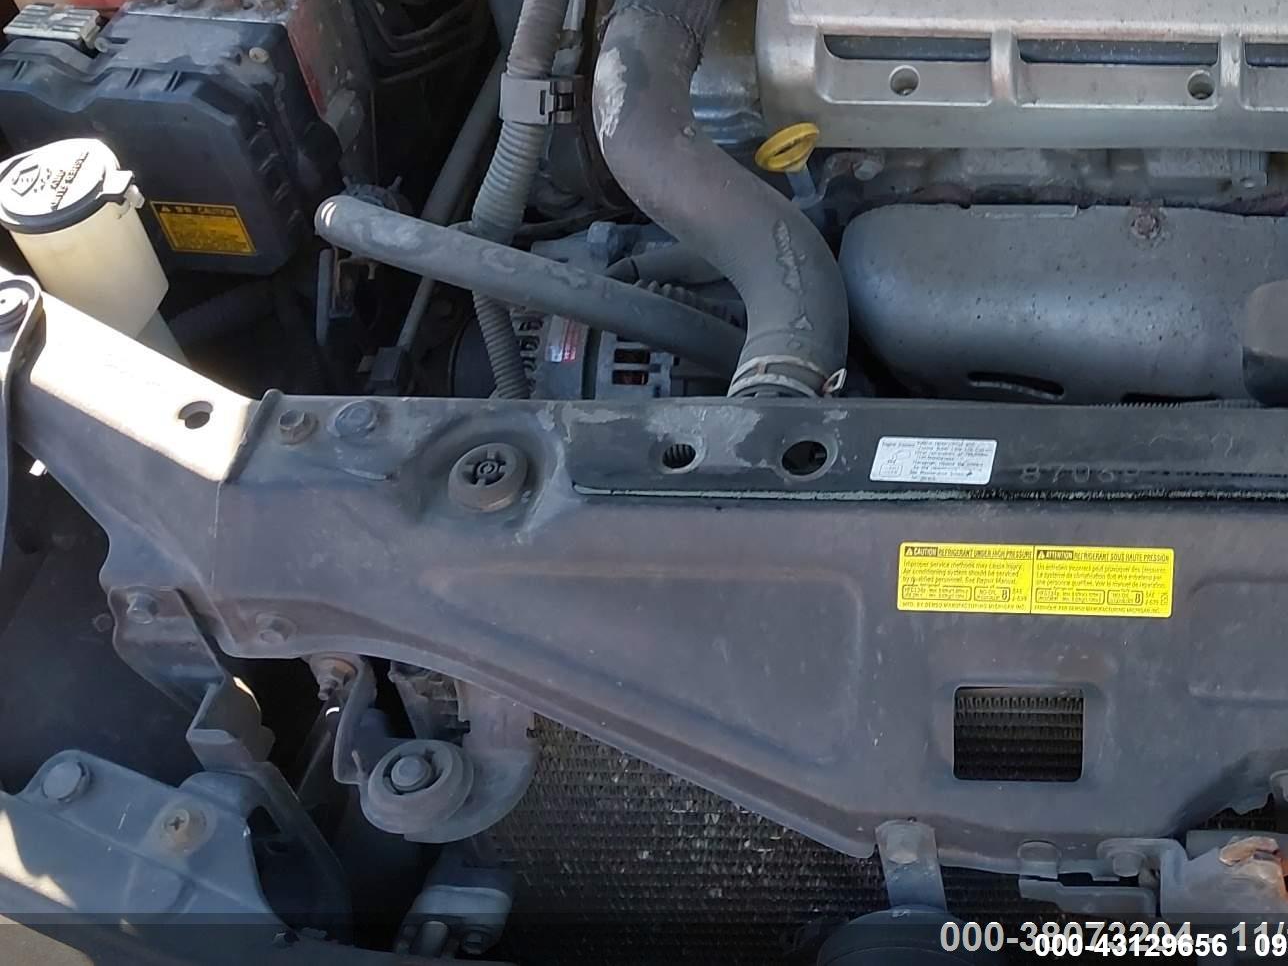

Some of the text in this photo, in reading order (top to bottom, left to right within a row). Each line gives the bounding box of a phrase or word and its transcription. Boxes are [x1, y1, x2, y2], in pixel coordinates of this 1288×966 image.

[913, 547, 937, 556] CAUTION
[1110, 553, 1124, 562] SOUS
[1126, 553, 1143, 562] HAUTE
[1144, 554, 1169, 563] PRESSION
